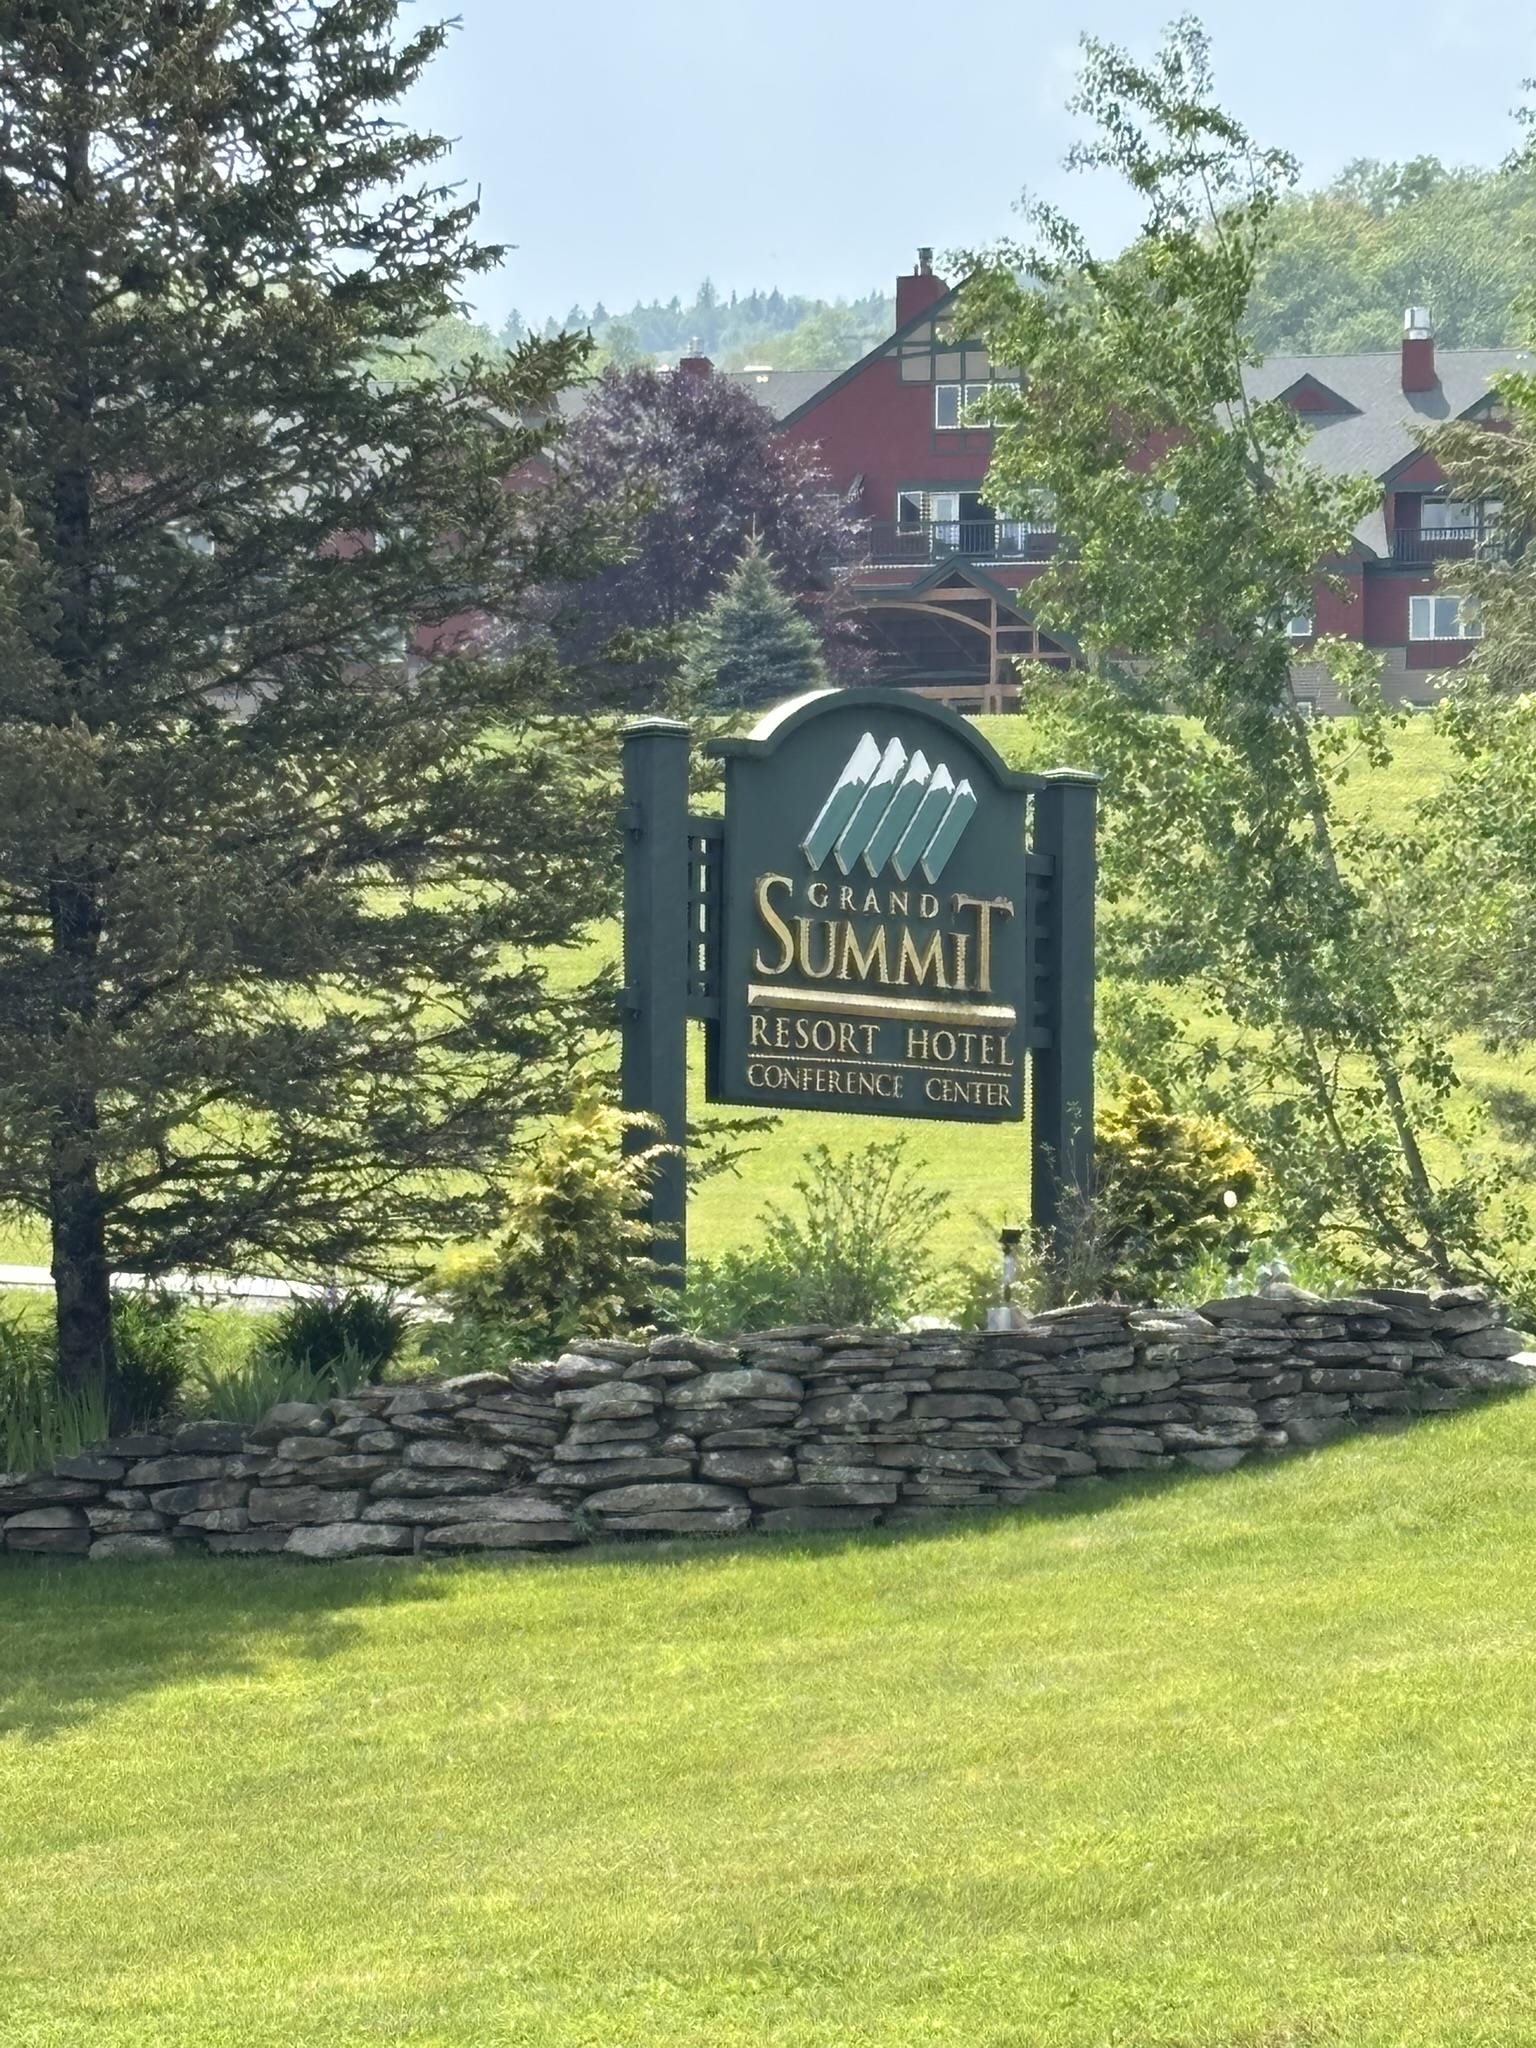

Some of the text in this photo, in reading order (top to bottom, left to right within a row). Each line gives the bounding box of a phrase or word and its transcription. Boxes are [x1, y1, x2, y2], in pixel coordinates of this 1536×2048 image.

[807, 882, 939, 918] GRAND
[754, 872, 1014, 993] SUMMIT
[750, 1014, 1014, 1066] RESORT HOTEL
[748, 1063, 1012, 1107] CONFERENCE CENTER
